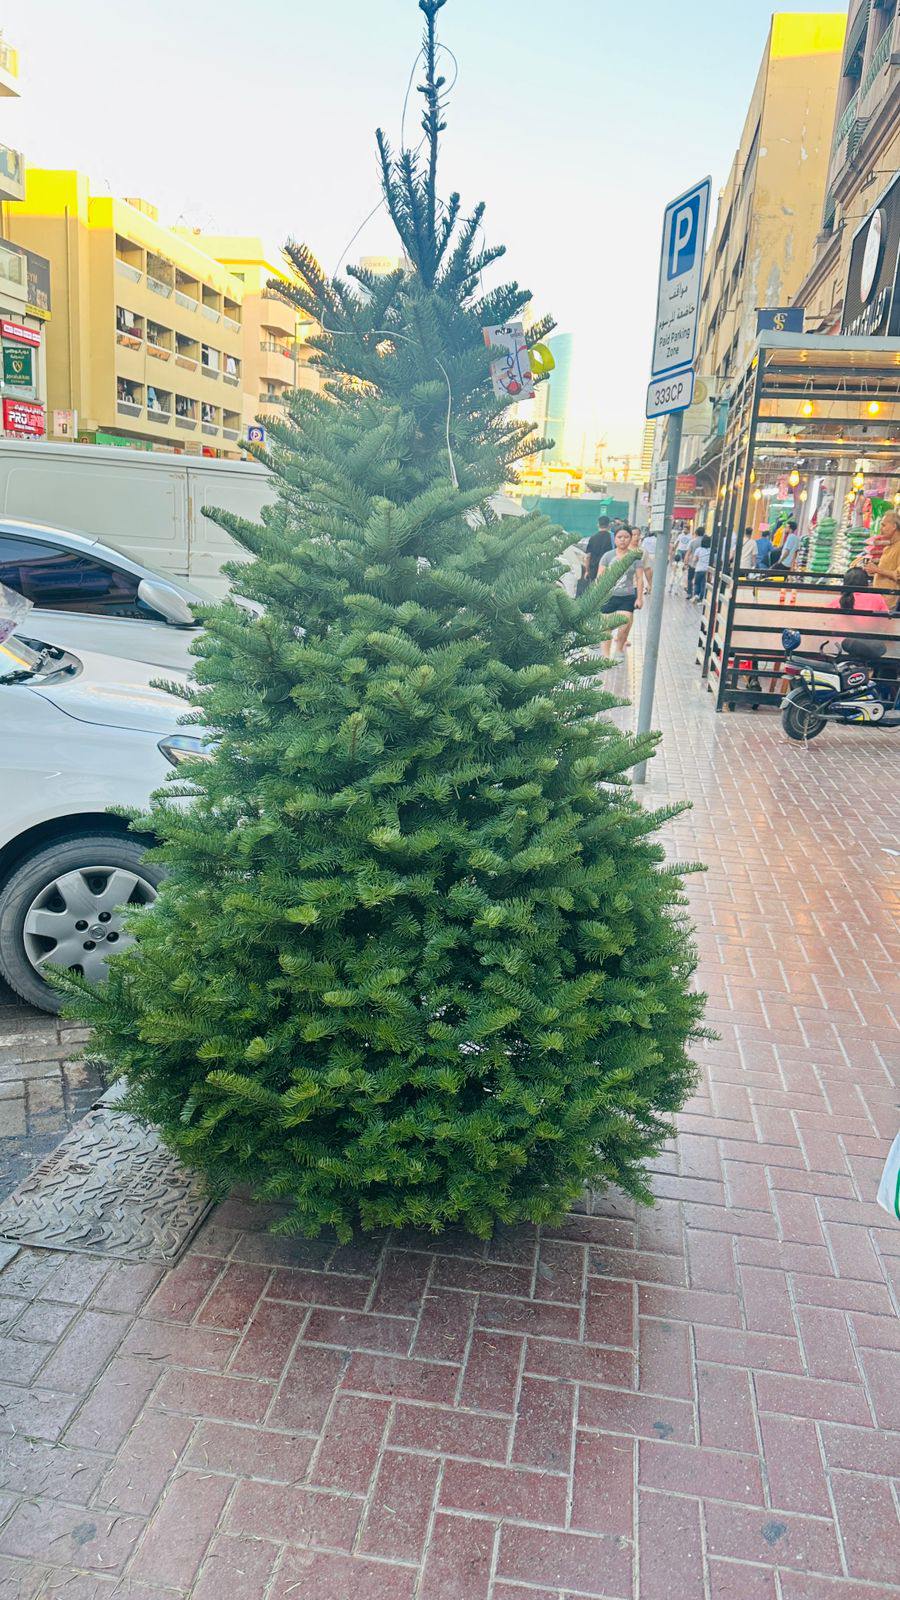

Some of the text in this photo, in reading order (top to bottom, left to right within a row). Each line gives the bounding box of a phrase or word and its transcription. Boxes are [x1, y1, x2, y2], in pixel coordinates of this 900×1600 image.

[672, 206, 693, 275] P
[669, 284, 688, 300] مواقف
[659, 328, 691, 347] Paid Parking
[666, 347, 679, 358] Zone
[655, 382, 684, 406] 333CP
